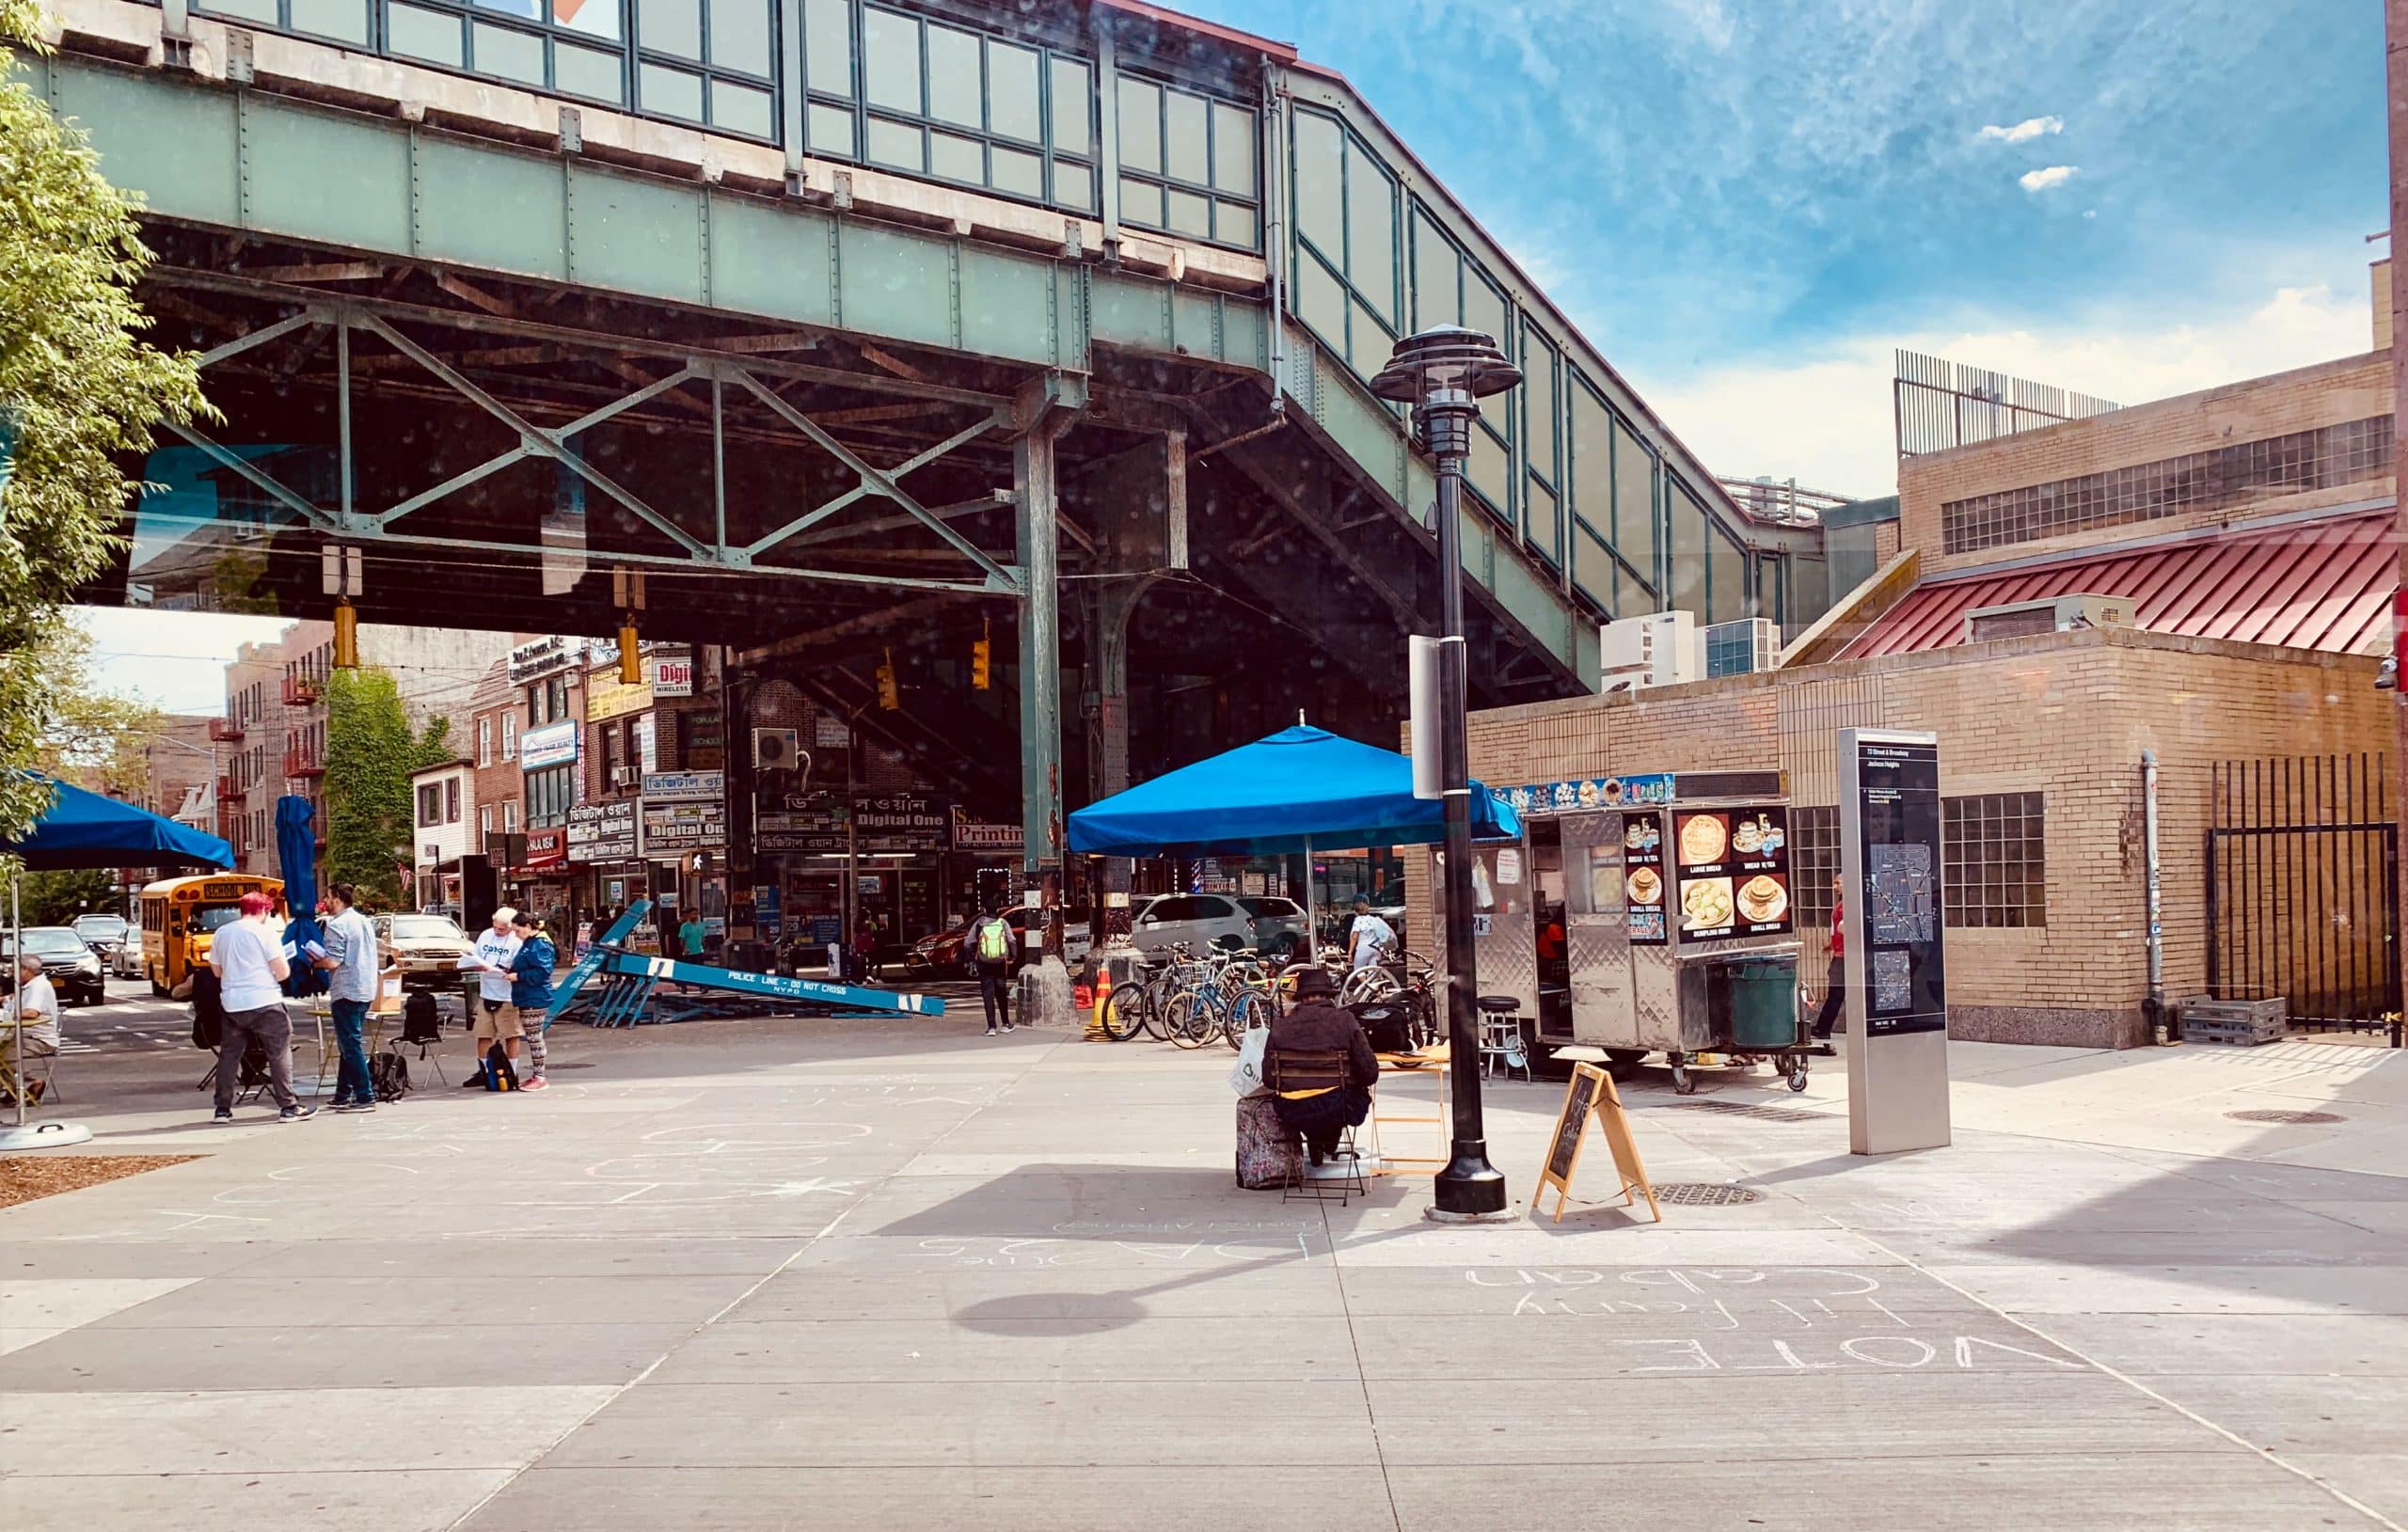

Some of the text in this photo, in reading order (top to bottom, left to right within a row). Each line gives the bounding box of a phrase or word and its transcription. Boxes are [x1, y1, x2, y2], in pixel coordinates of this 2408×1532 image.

[659, 664, 691, 685] Digi
[857, 813, 943, 827] Digital One
[651, 824, 702, 837] Digital
[206, 885, 238, 897] SCHOOL
[728, 971, 755, 983] POLICE
[761, 976, 779, 986] LINE
[790, 980, 800, 989] DO
[803, 981, 818, 991] NOT
[821, 985, 847, 995] CROSS
[773, 986, 800, 995] NYPD
[1612, 1335, 2083, 1371] VOTE
